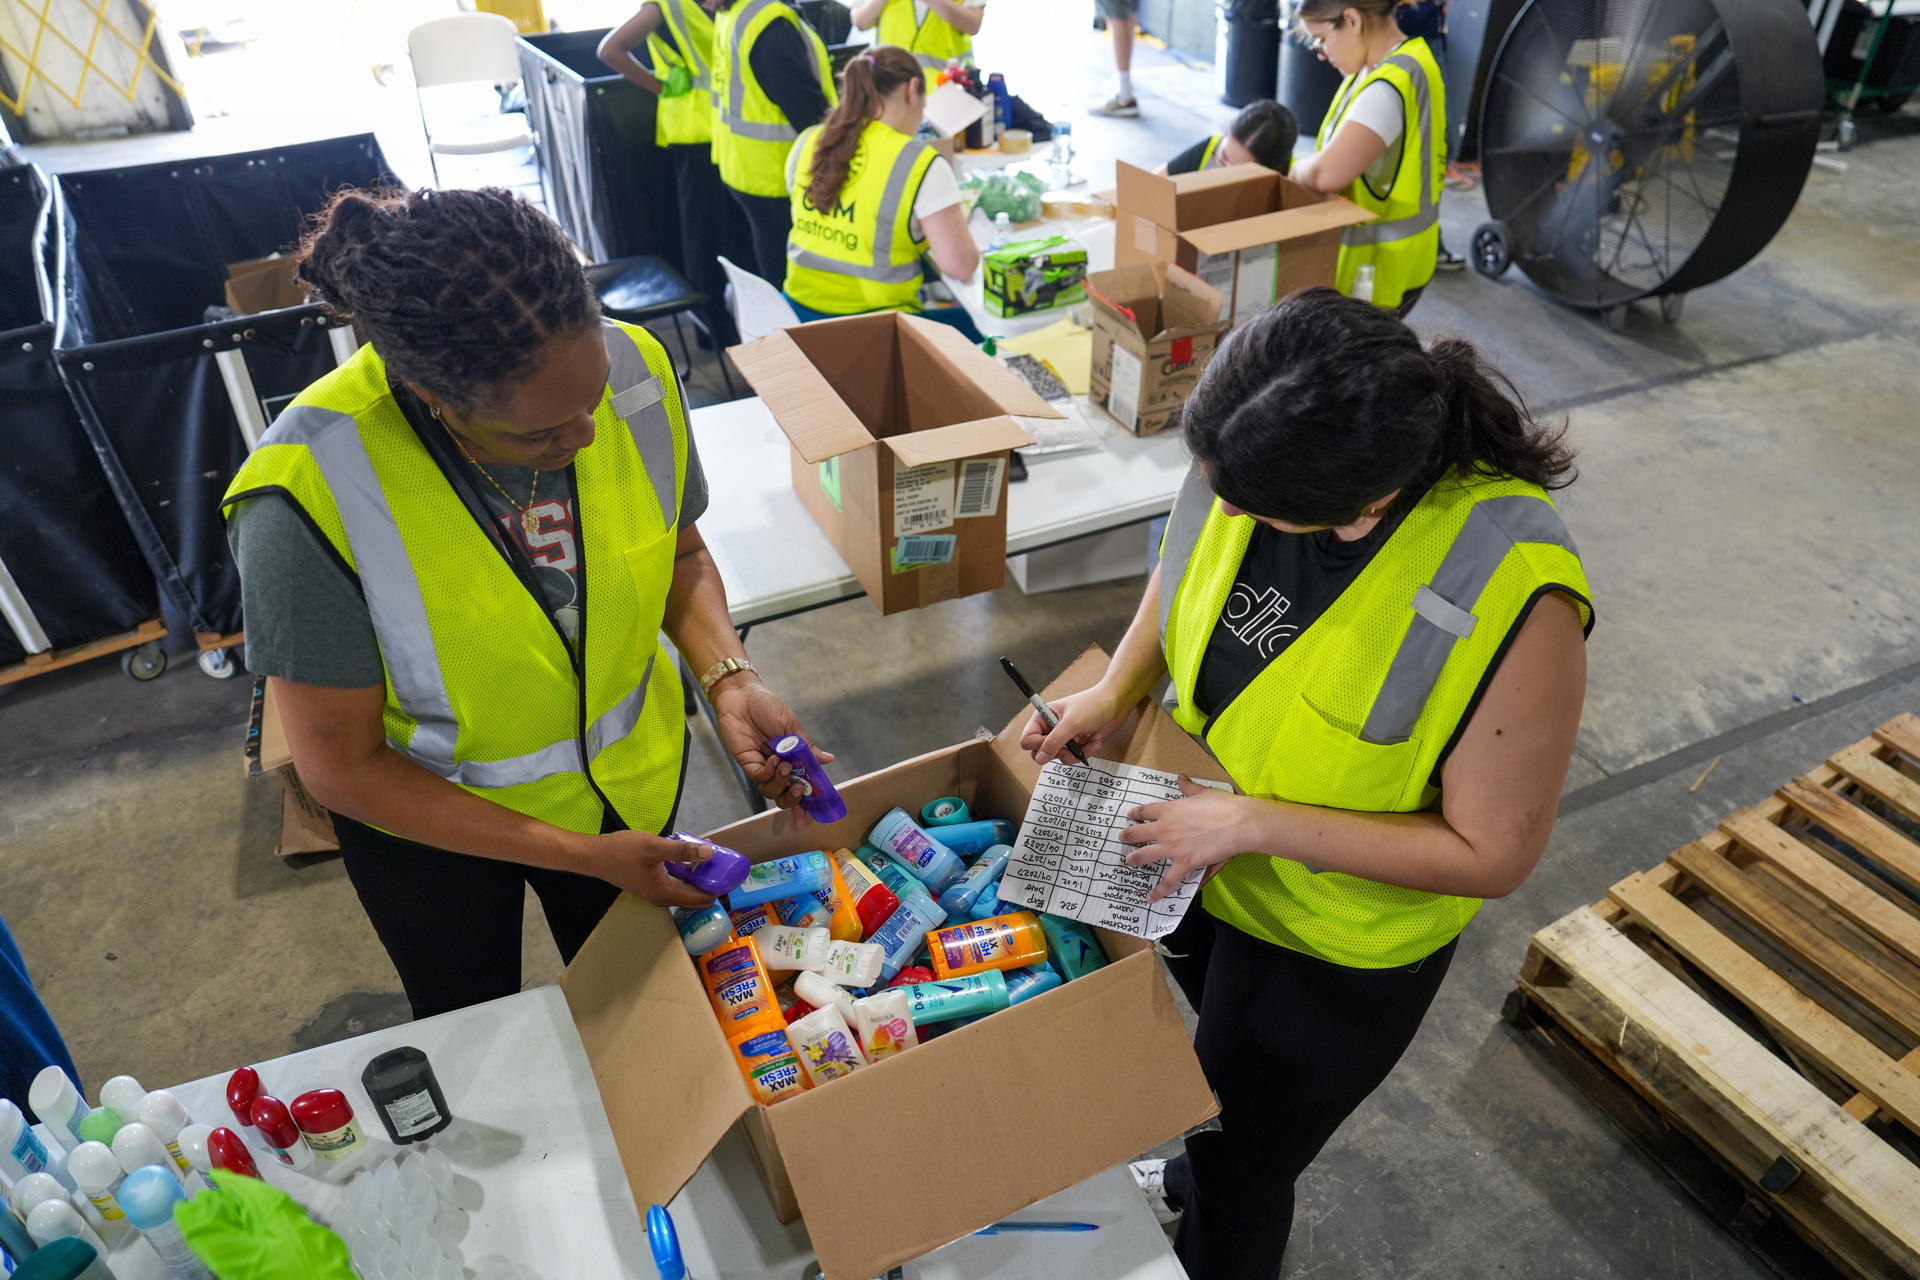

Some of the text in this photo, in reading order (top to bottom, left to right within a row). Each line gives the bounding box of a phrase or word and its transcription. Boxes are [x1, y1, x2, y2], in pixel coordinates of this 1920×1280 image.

[814, 887, 832, 900] FRE
[973, 925, 992, 957] FRSH
[720, 978, 757, 1000] FRESH
[728, 989, 754, 1006] MAX
[759, 1064, 798, 1086] FRESH
[768, 1075, 797, 1093] MAX
